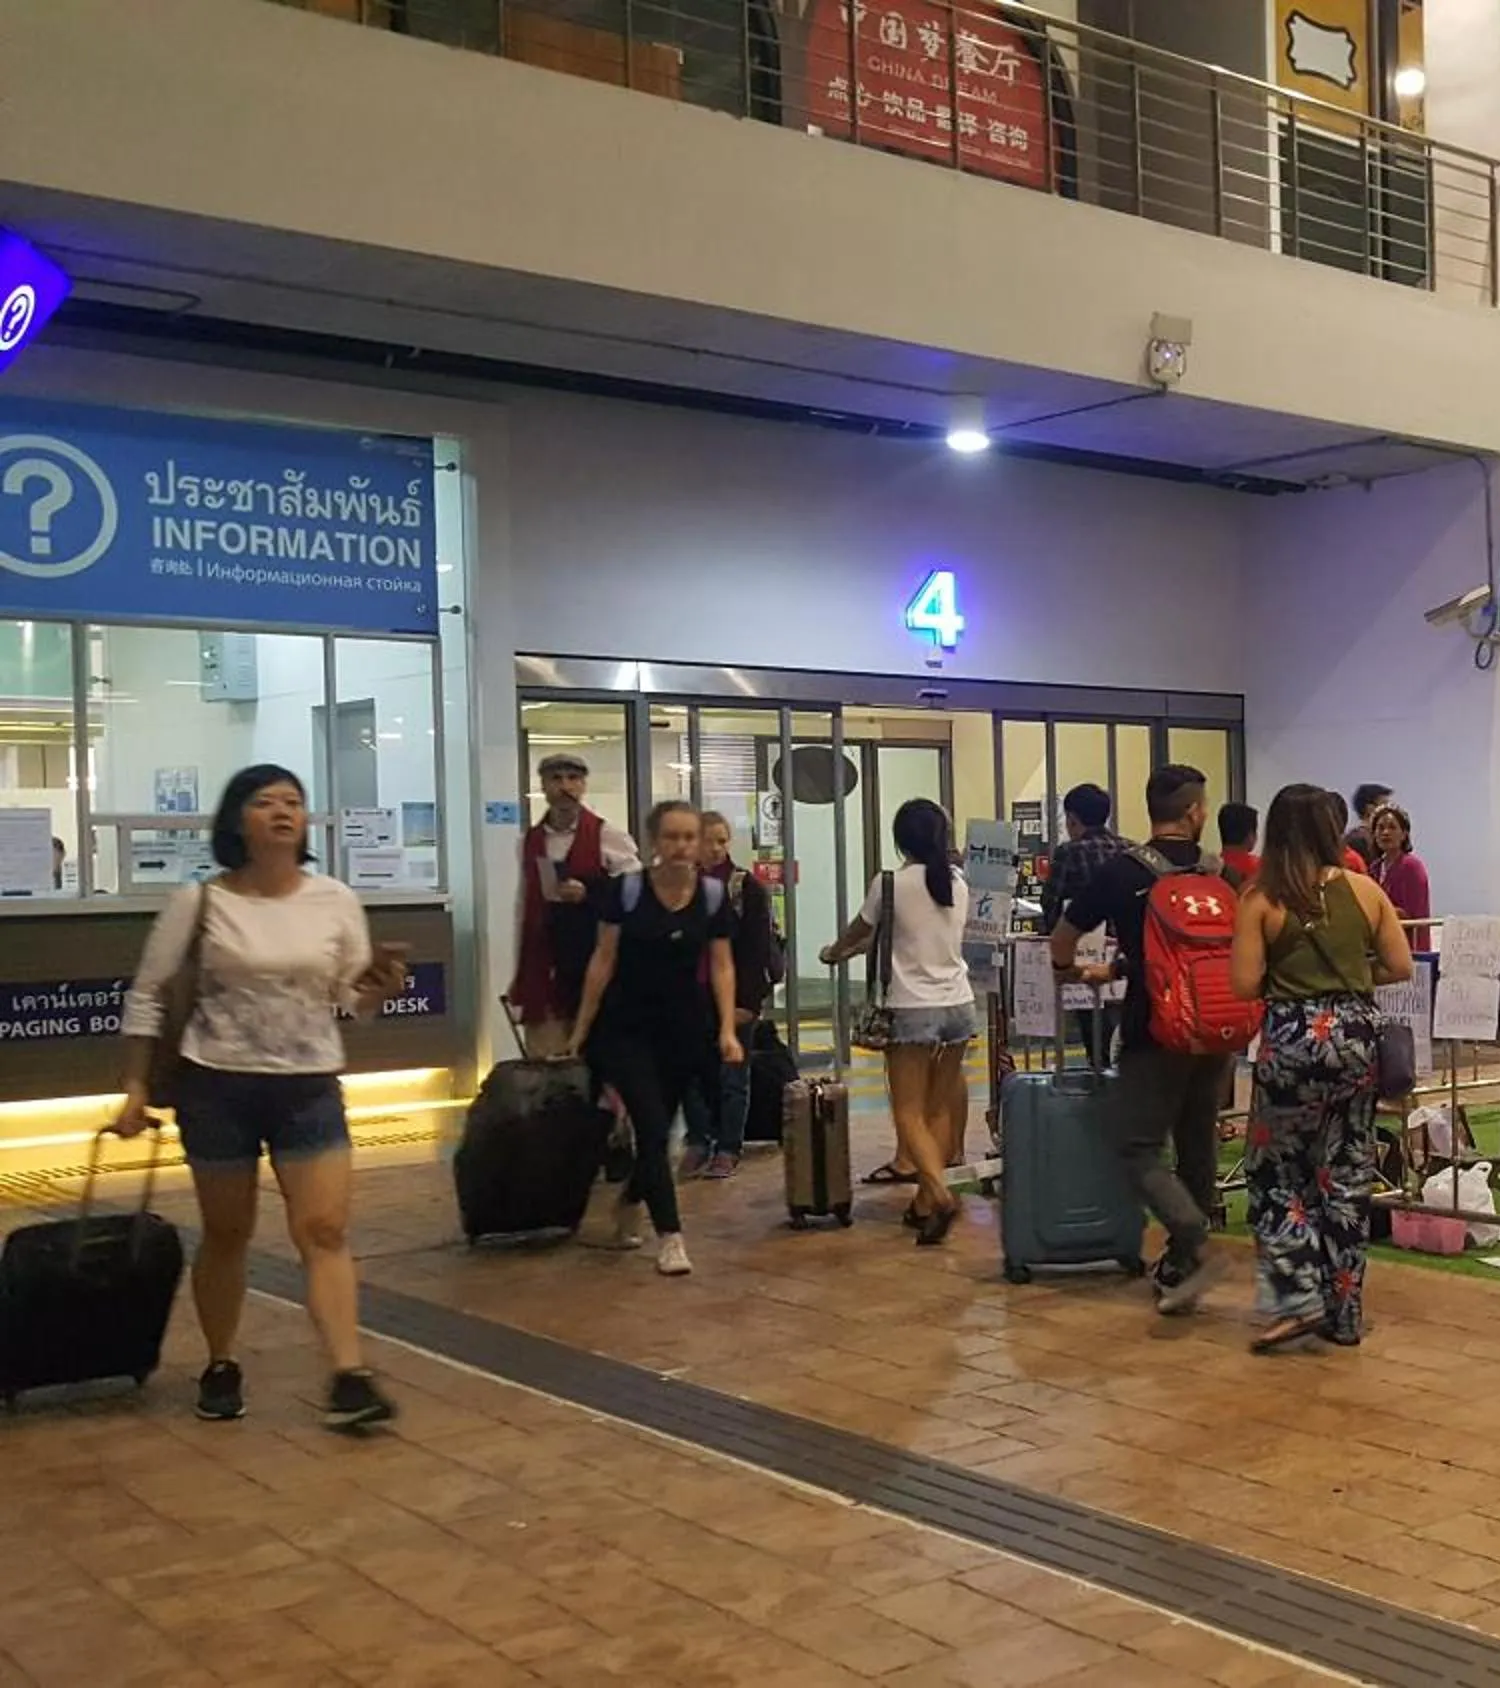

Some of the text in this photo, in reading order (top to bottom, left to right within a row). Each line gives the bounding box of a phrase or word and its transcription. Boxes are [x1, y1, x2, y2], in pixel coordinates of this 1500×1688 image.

[868, 55, 926, 85] CHINA
[144, 460, 423, 527] ประชาสัมพันธ์
[152, 516, 421, 569] INFORMATION
[206, 561, 422, 593] Информационная стойка
[904, 570, 966, 648] 4
[383, 996, 429, 1015] DESK
[0, 1015, 121, 1038] PAGING BO
